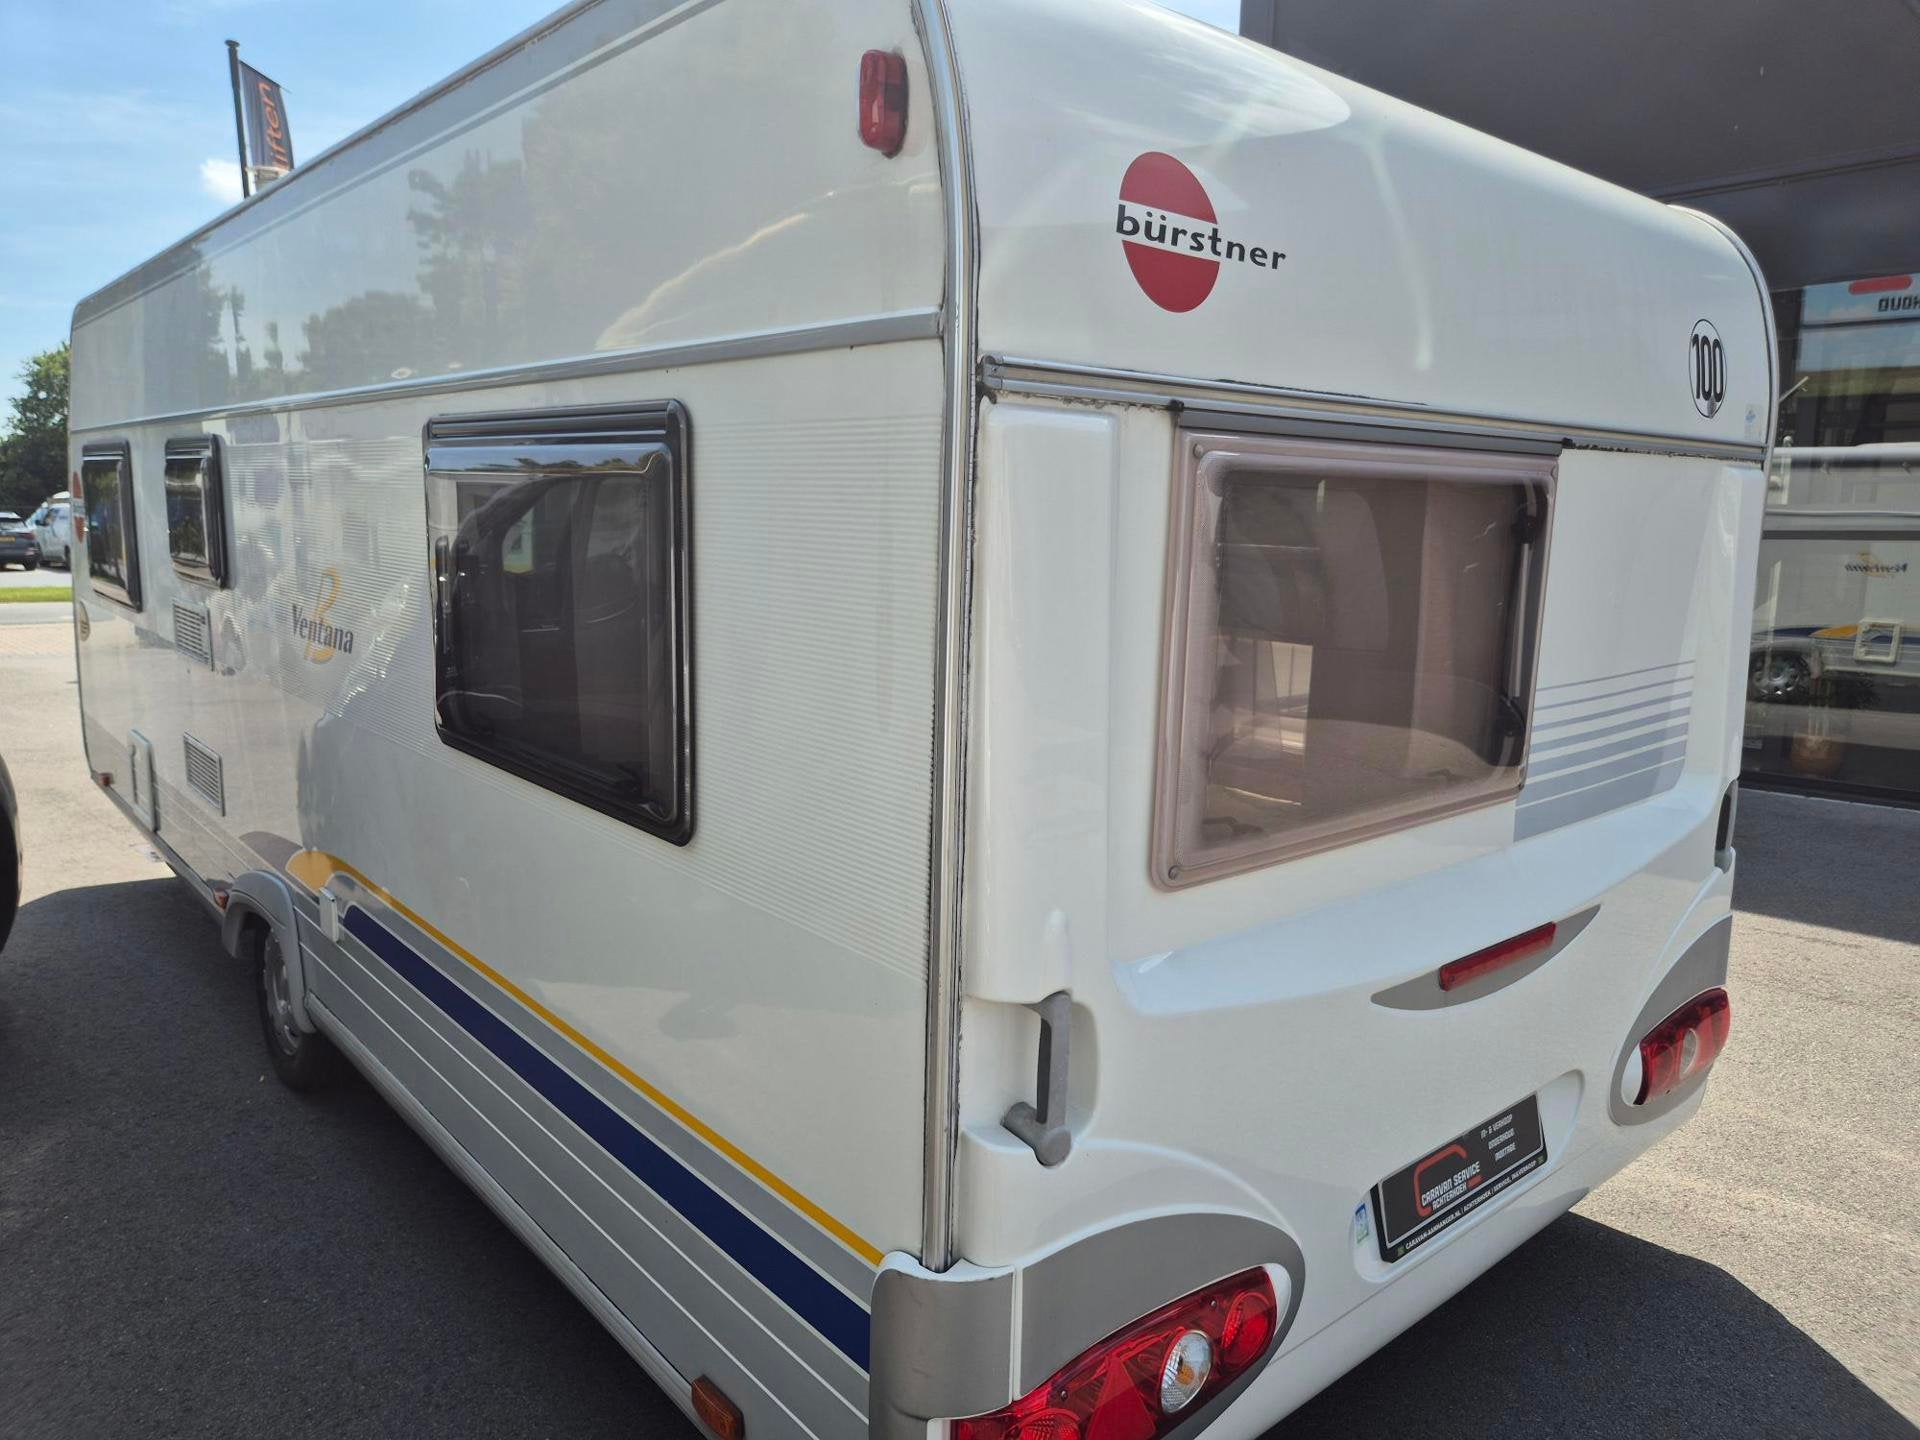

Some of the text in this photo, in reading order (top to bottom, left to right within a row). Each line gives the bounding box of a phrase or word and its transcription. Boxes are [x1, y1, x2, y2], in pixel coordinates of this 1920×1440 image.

[1116, 204, 1286, 270] bürstner
[1691, 333, 1724, 402] 100
[291, 603, 354, 654] Ventana
[1421, 1161, 1480, 1207] CARAVAN SERVICE
[1432, 1182, 1467, 1211] ACHTERHOEK
